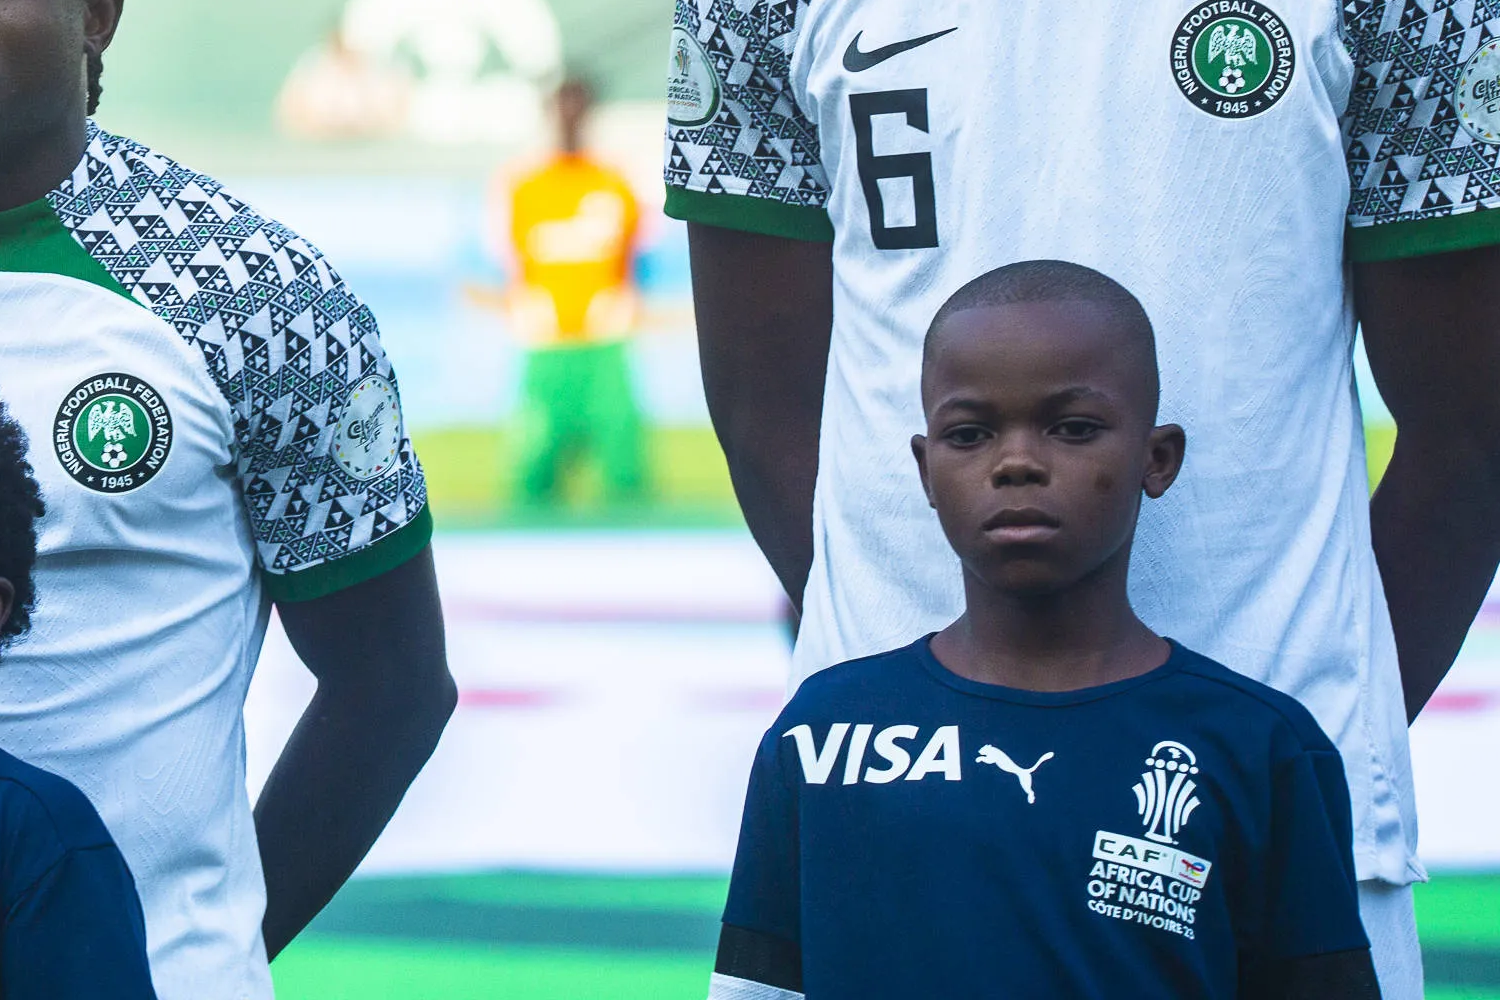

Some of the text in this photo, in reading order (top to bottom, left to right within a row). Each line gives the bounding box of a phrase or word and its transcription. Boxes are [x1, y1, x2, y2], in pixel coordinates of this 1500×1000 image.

[1173, 0, 1292, 100] NIGERIA FOOTBALL FEDERATION
[1214, 100, 1249, 114] 1945
[848, 87, 939, 250] 6
[56, 377, 170, 475] NIGERIA FOOTBALL FEDERATION
[100, 474, 133, 489] 1945
[782, 723, 961, 785] VISA
[1099, 838, 1161, 863] CAF
[1087, 879, 1196, 924] OF NATIONS
[1089, 860, 1201, 905] AFRICA CUP
[1087, 899, 1122, 919] CÔTE
